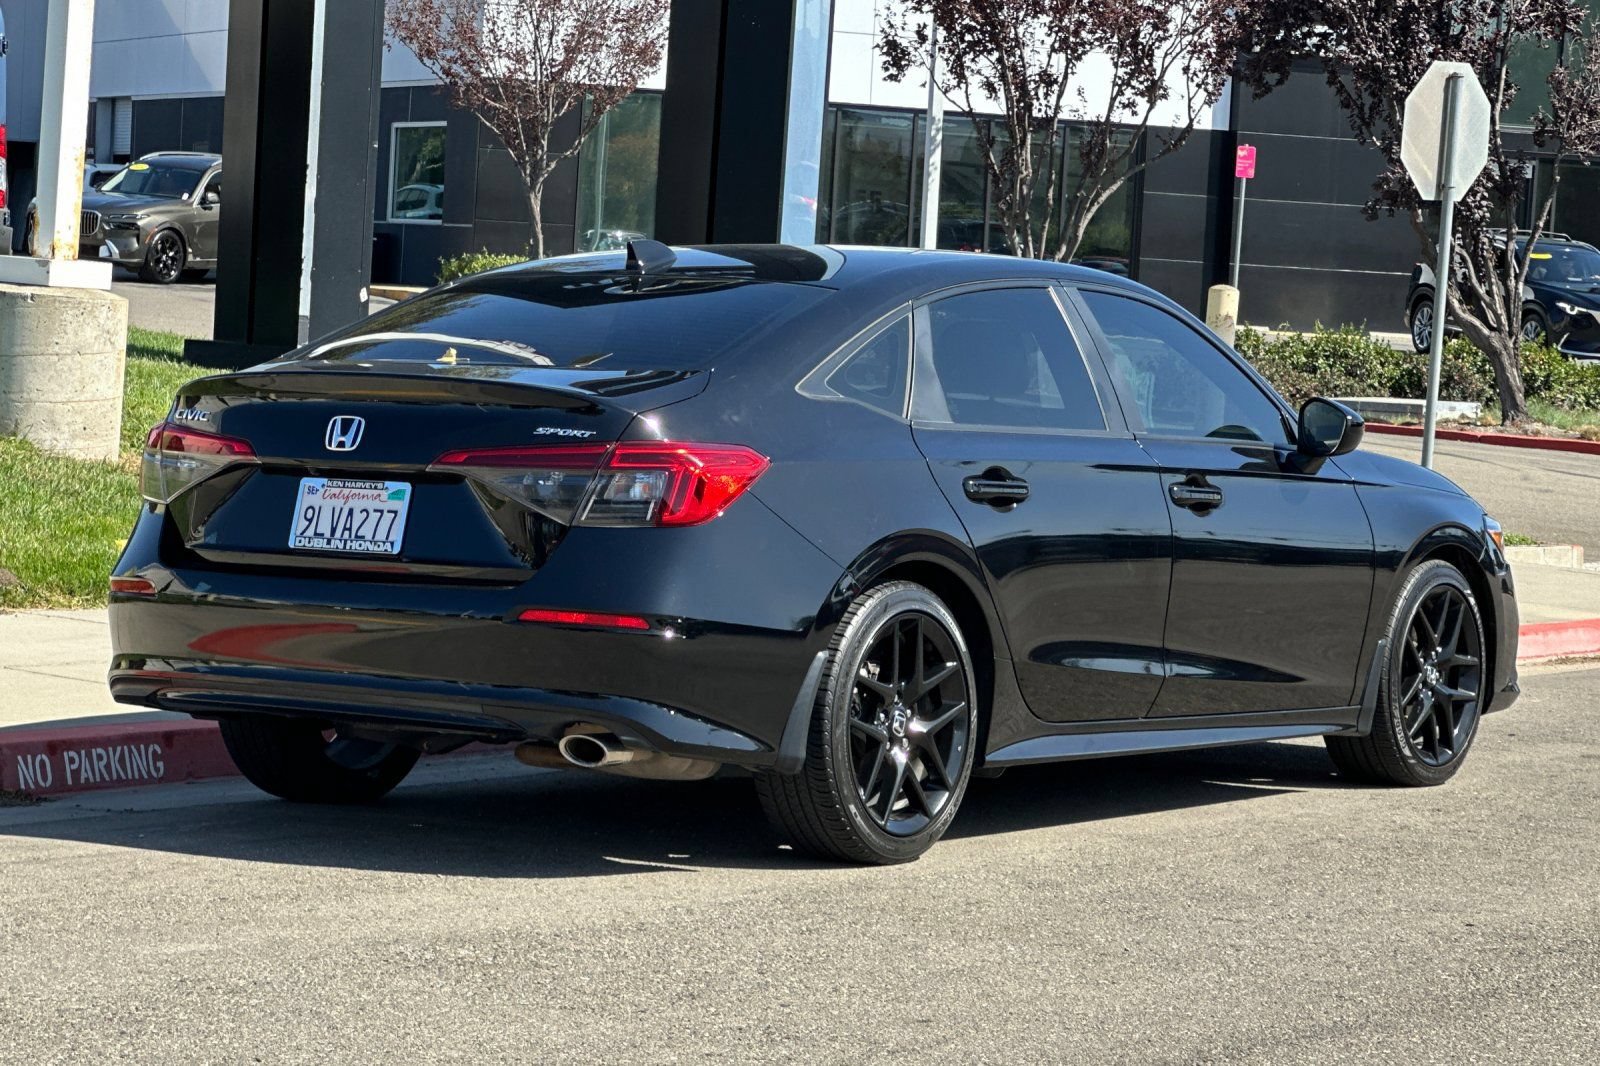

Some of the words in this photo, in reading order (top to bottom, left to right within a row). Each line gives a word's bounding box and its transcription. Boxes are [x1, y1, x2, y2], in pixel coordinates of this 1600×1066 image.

[175, 409, 211, 422] CIVIC
[533, 427, 597, 438] SPORT
[327, 481, 344, 489] KEN
[322, 488, 388, 505] California
[300, 505, 399, 541] 9LVA277
[295, 537, 344, 550] DUBLIN
[345, 540, 393, 552] HONDA
[17, 753, 53, 790] NO
[63, 743, 165, 786] PARKING
